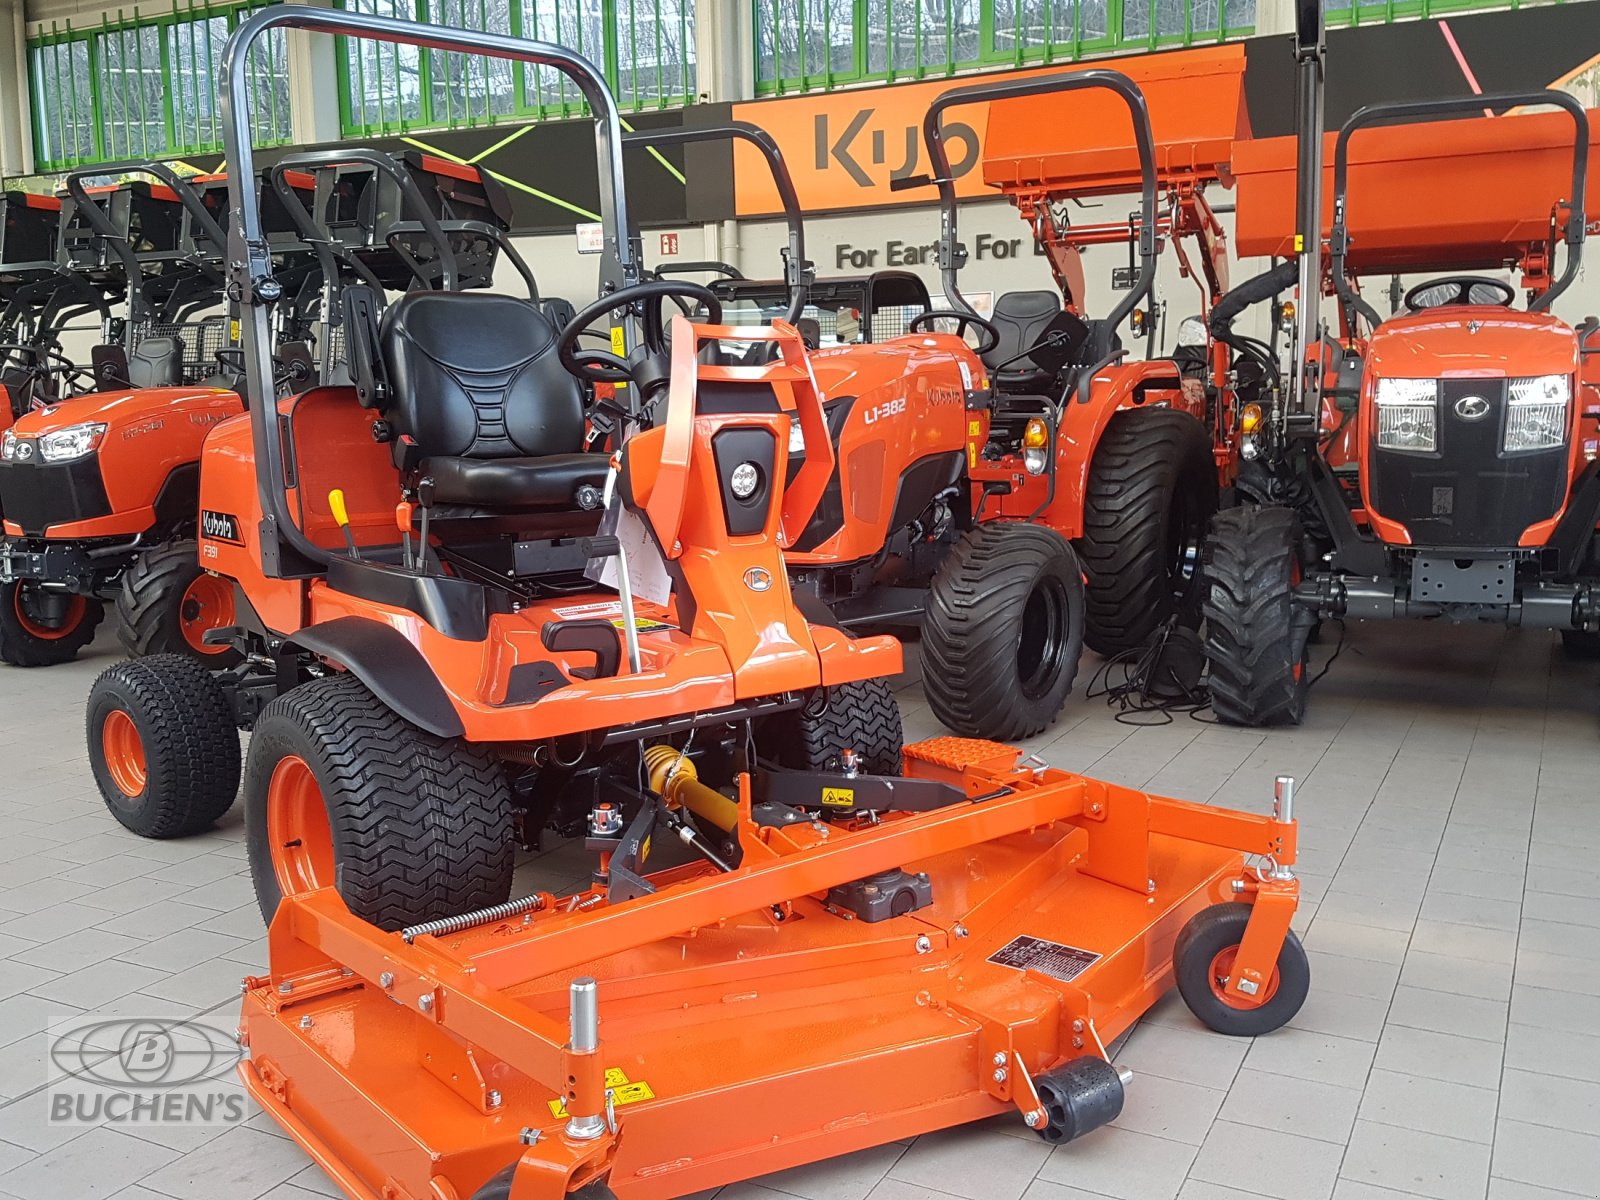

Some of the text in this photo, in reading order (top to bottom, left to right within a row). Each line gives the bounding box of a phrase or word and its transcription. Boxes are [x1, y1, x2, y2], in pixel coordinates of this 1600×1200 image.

[836, 243, 878, 269] For
[975, 233, 1021, 261] For
[926, 388, 961, 407] Kubota
[203, 511, 232, 538] Kubota
